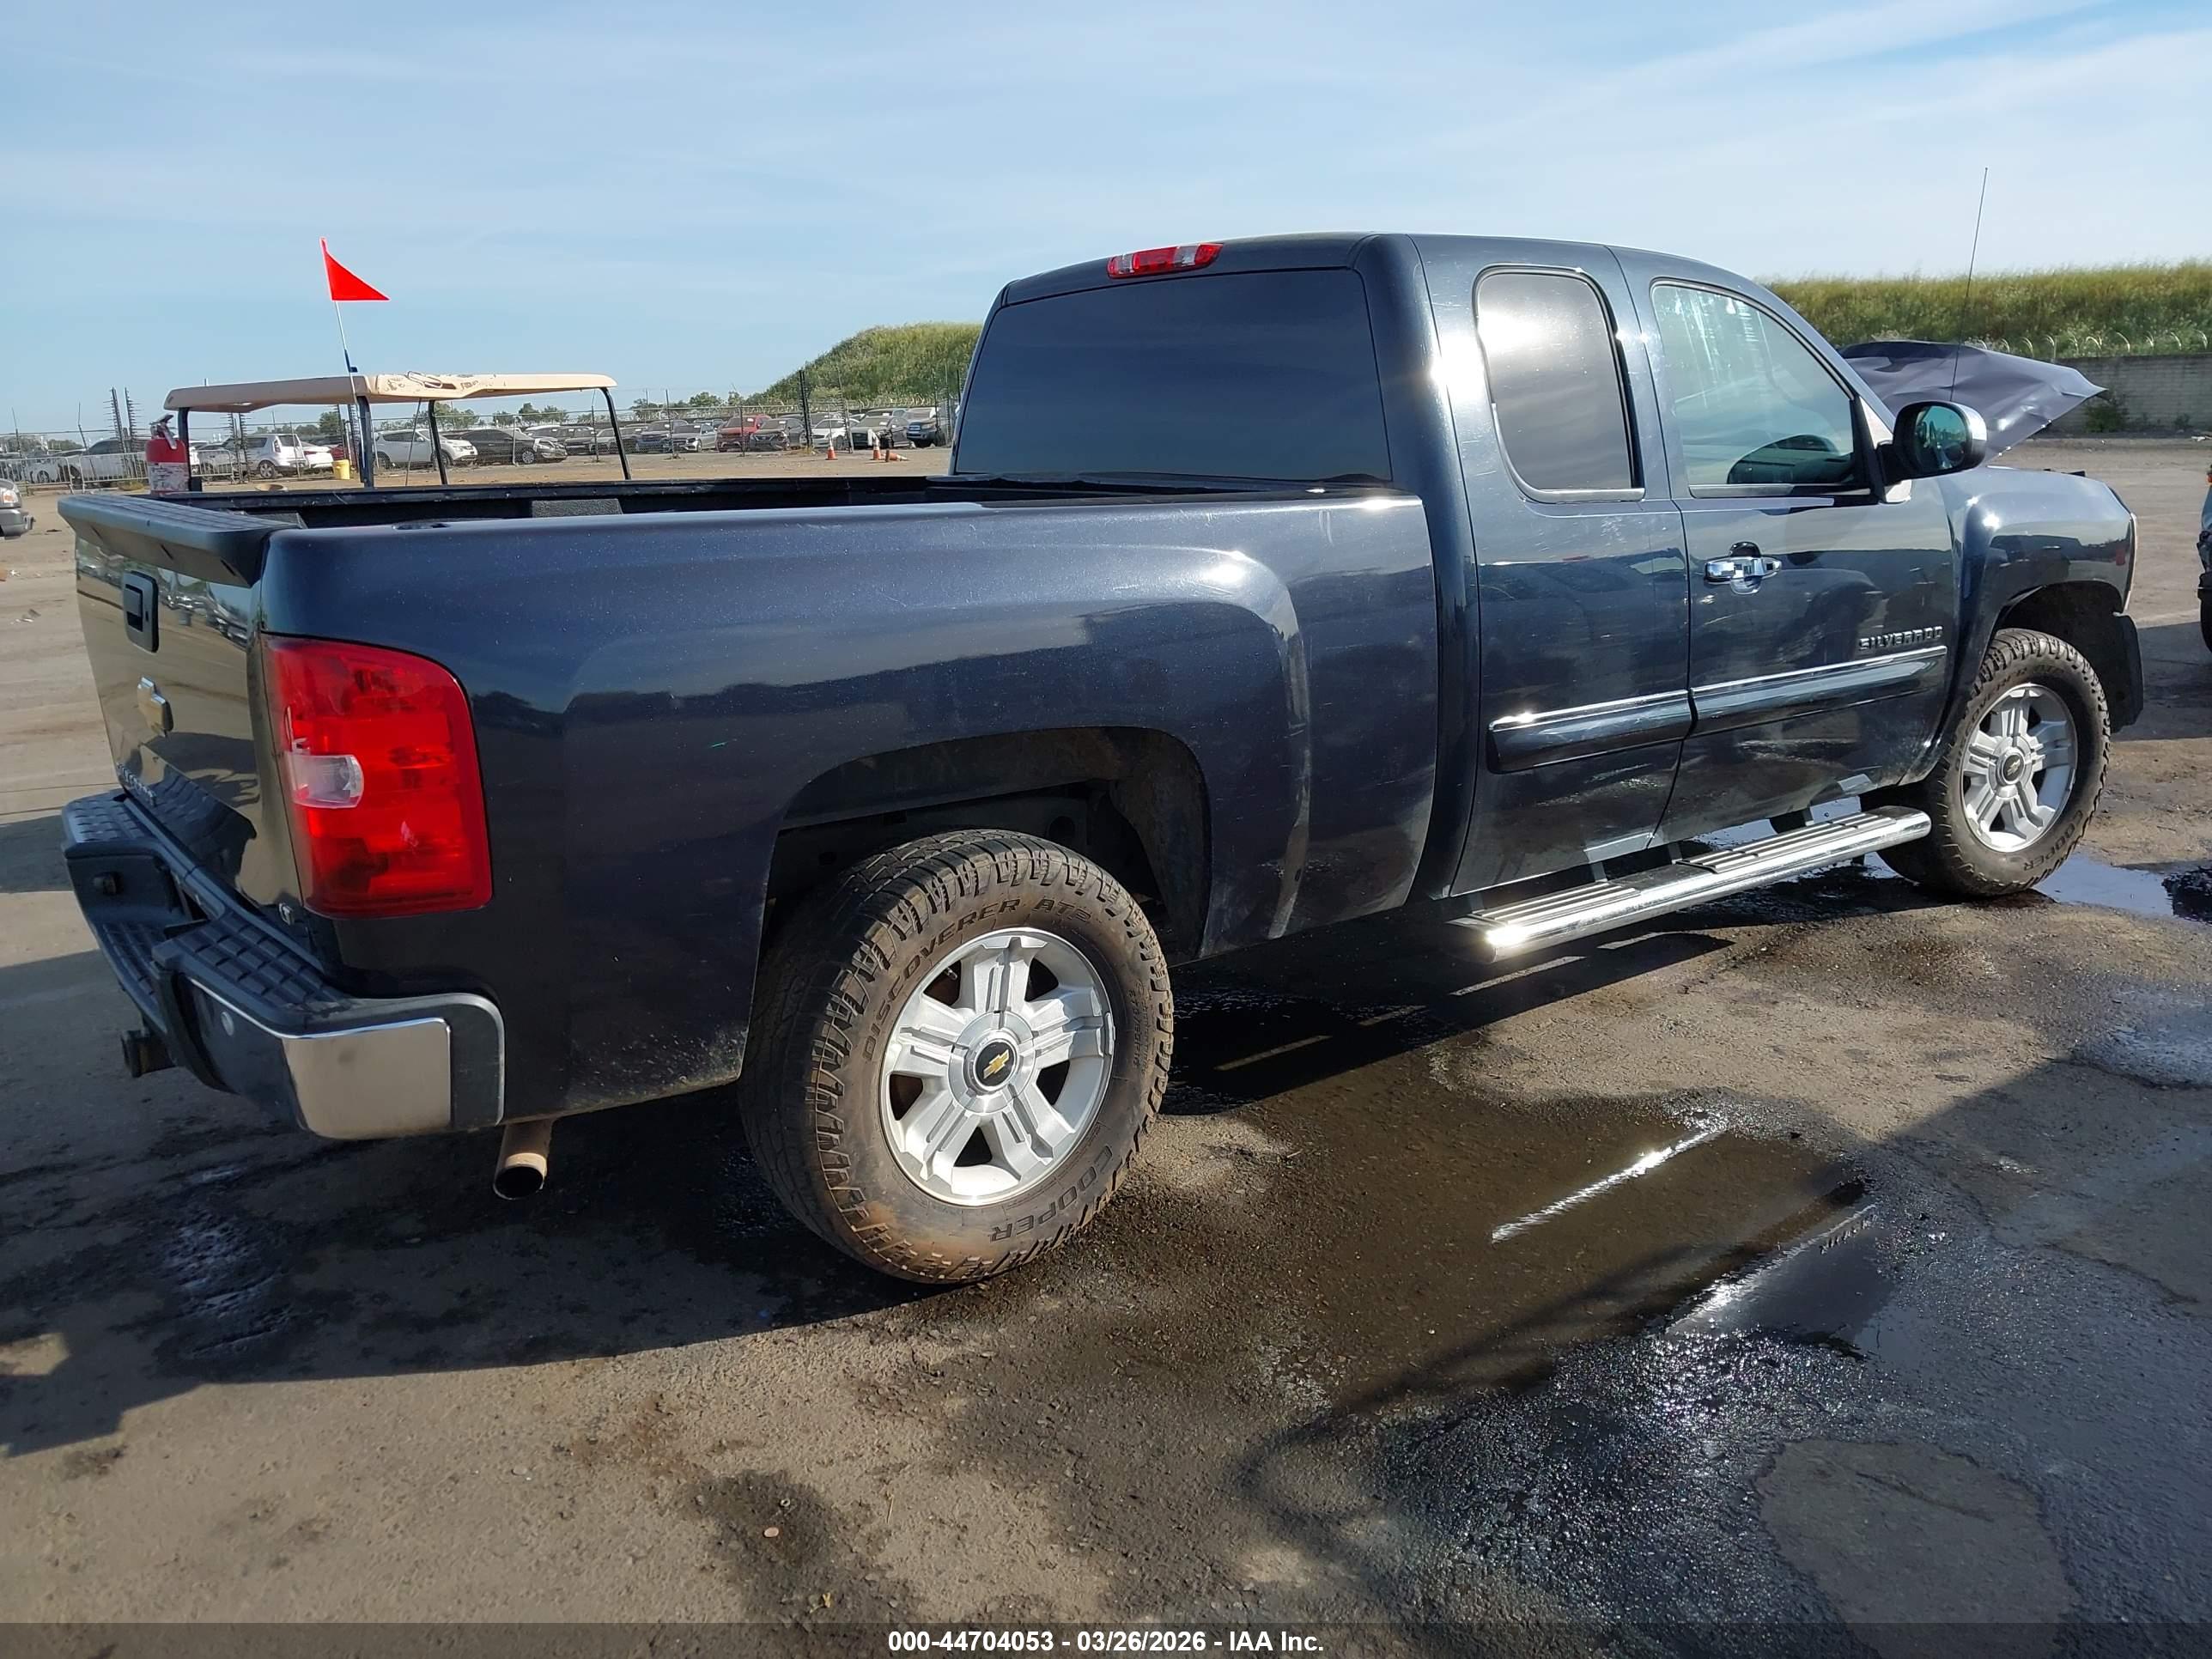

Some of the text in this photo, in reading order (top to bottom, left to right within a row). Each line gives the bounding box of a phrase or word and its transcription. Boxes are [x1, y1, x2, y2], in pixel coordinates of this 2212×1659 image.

[1858, 625, 1943, 651] SILVERADO
[2023, 810, 2084, 872] COOPER
[862, 898, 1021, 1060] DISCOVERER
[989, 1145, 1113, 1243] COOPER
